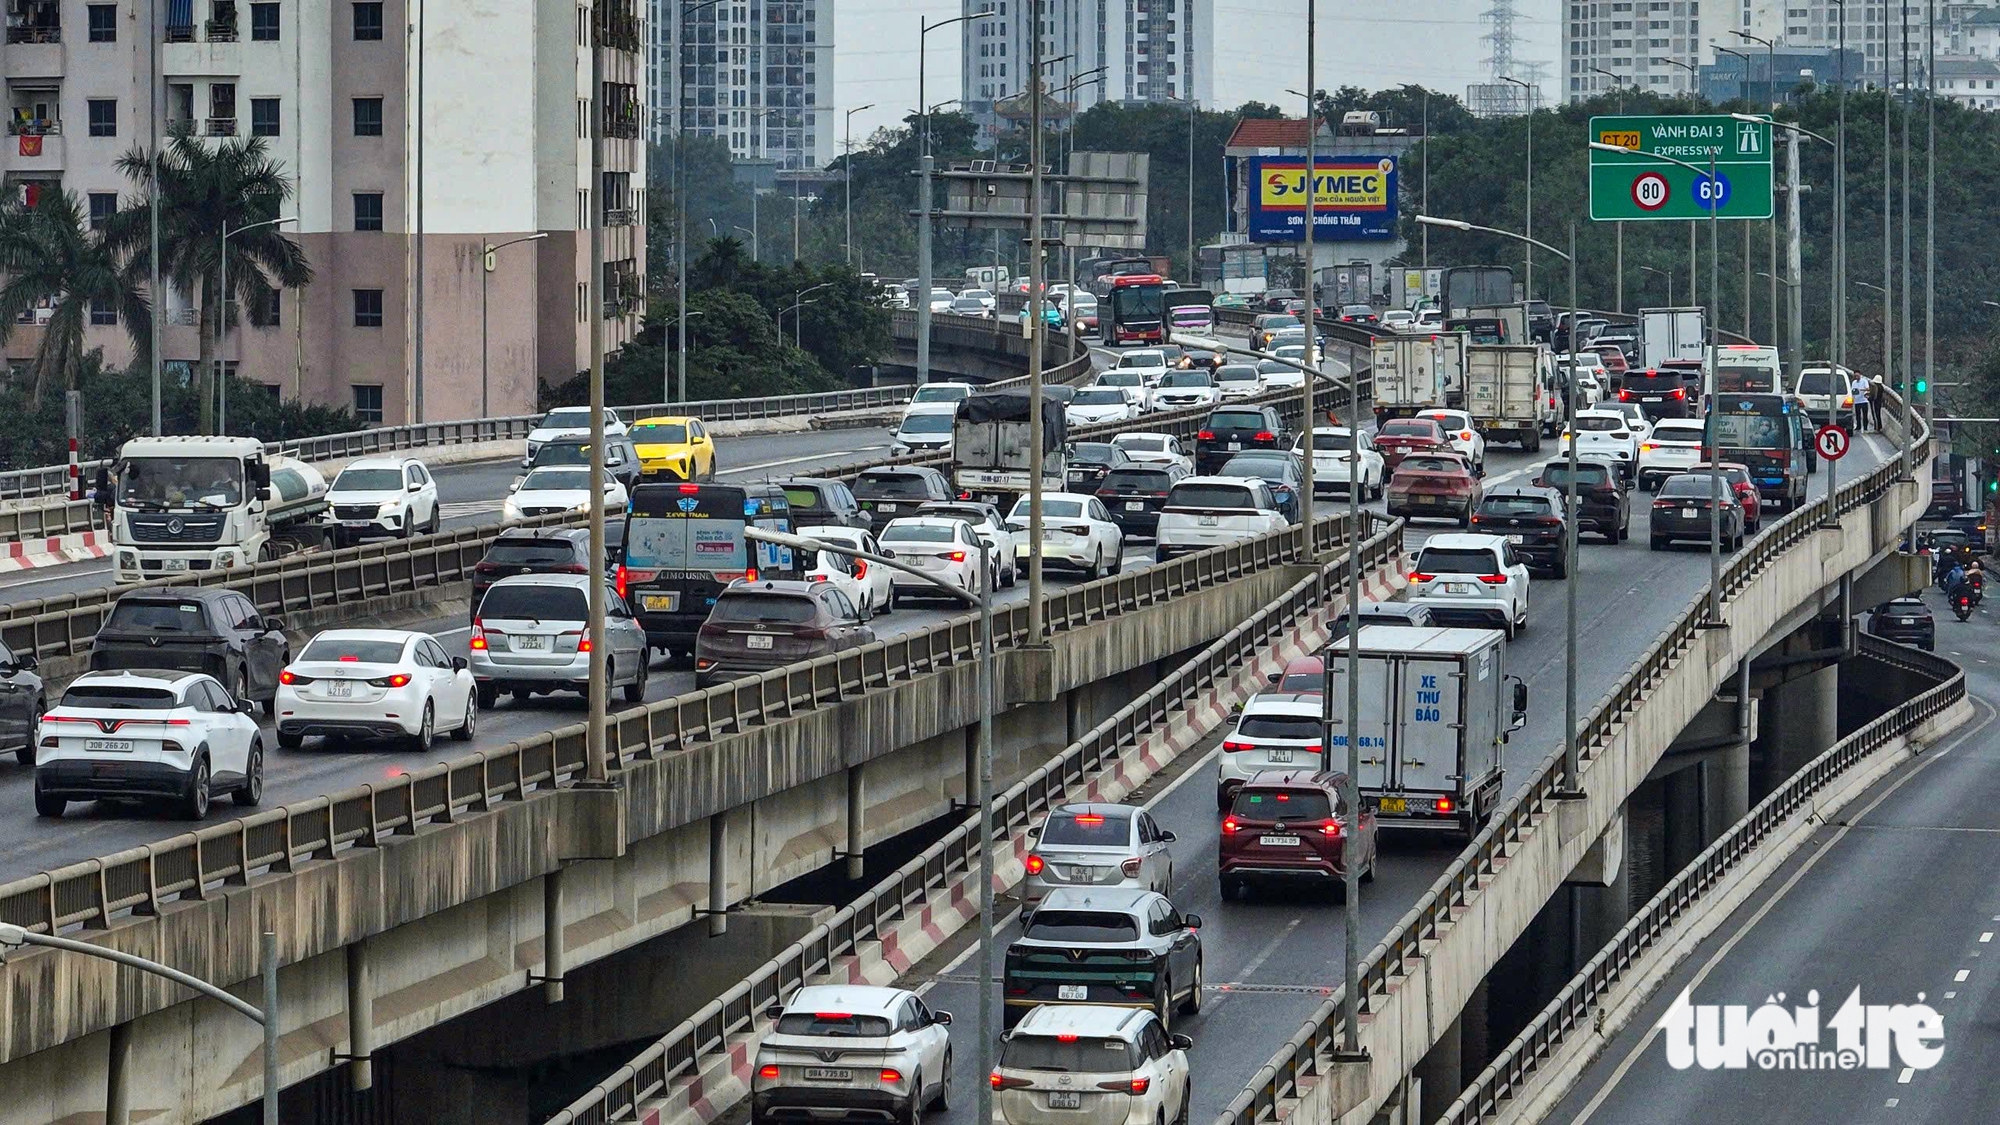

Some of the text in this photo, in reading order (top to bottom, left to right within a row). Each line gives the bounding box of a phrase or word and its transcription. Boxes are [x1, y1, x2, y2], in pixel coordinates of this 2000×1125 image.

[1651, 123, 1724, 138] VÀNH ĐAI 3
[1654, 145, 1724, 156] EXPRESSWAY
[1291, 175, 1378, 194] JYMEC
[1642, 182, 1660, 200] 80
[1700, 181, 1724, 199] 60
[660, 571, 712, 581] LIMOUSINE
[1421, 675, 1437, 688] XE
[1416, 691, 1441, 704] THƯ
[1415, 705, 1440, 722] BÁO
